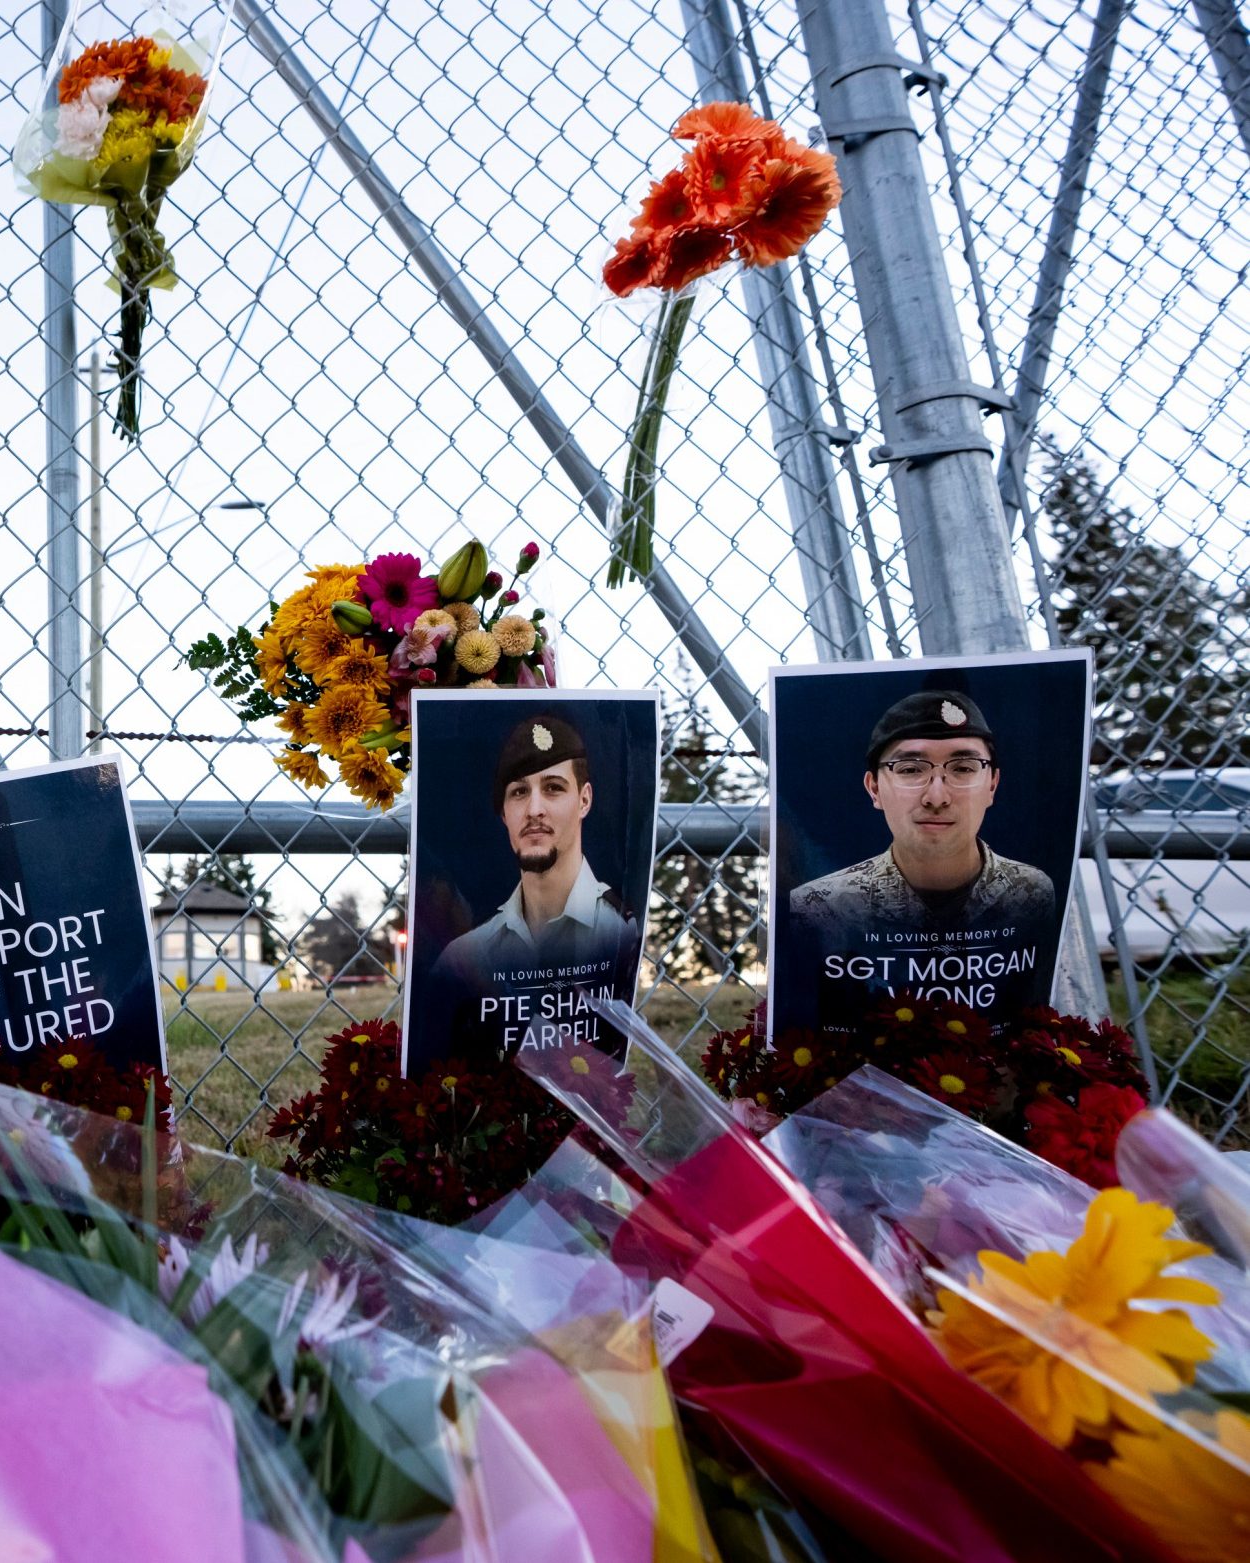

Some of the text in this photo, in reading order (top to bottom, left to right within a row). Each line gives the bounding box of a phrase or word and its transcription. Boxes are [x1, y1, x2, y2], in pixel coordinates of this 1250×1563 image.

[865, 927, 1016, 942] IN LOVING MEMORY OF
[493, 960, 611, 981] IN LOVING MEMORY OF
[824, 946, 1036, 981] SGT MORGAN
[13, 956, 95, 1004] THE
[481, 983, 615, 1022] PTE SHAUN
[823, 1025, 850, 1033] LOYAL
